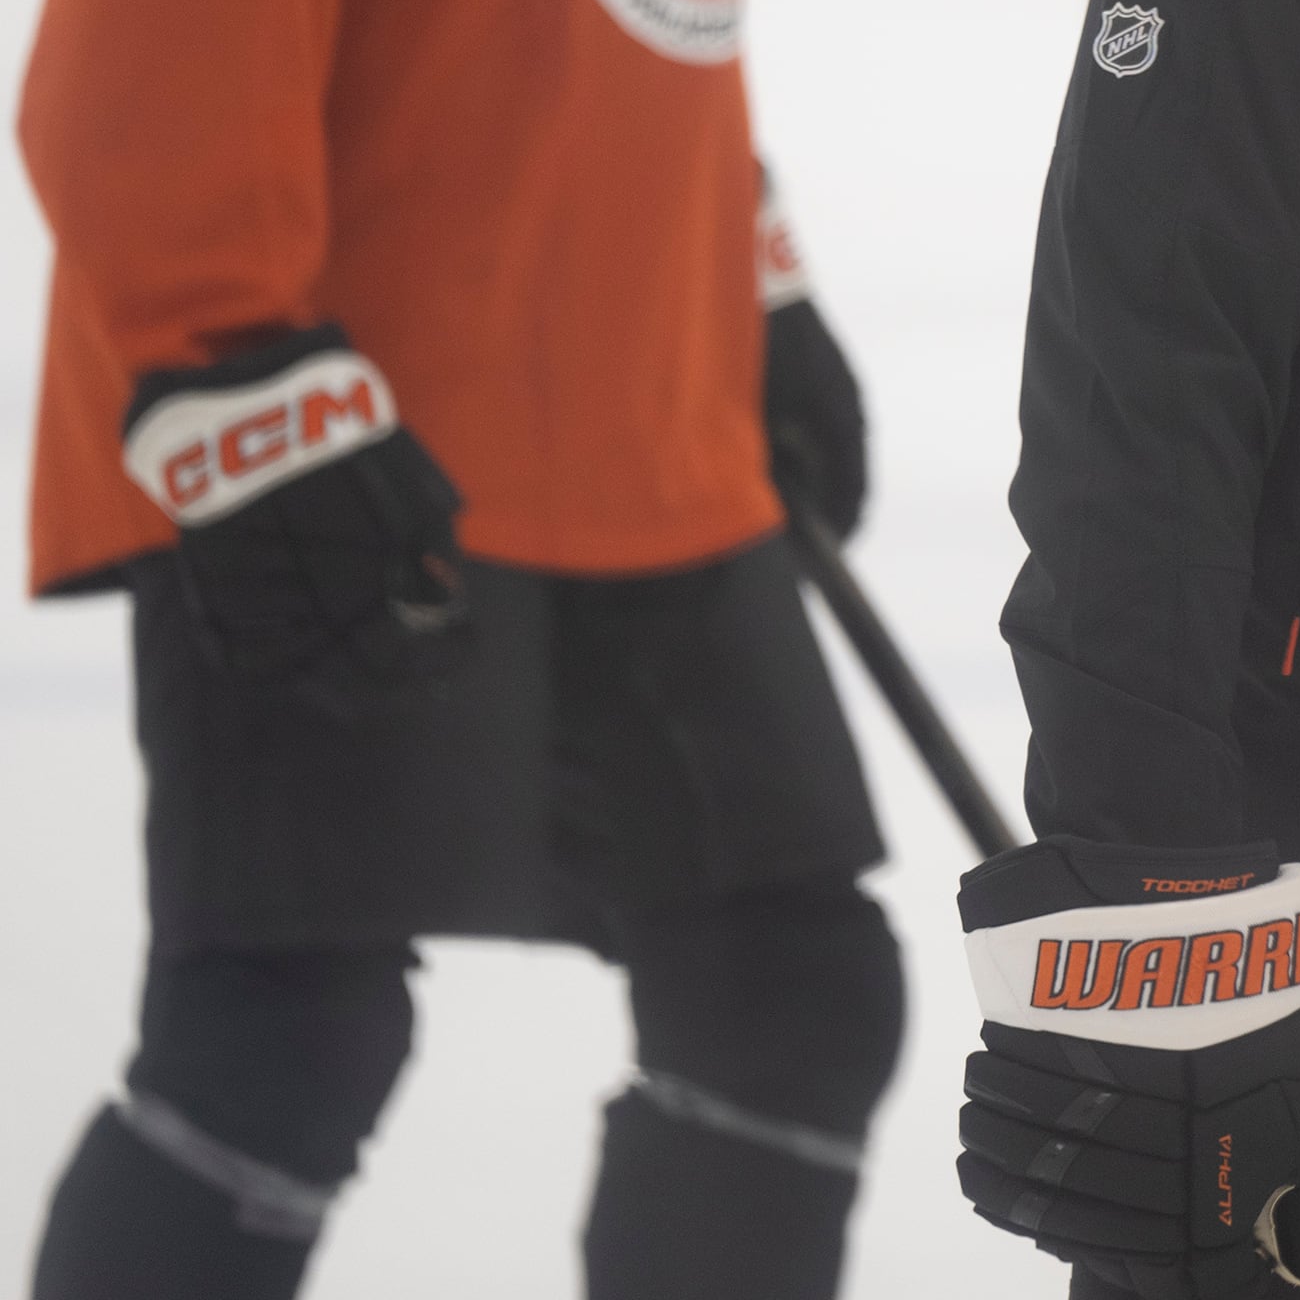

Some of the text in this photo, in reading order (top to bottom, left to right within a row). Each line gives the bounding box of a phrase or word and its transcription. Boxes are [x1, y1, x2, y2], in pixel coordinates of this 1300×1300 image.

[1106, 25, 1149, 58] NHL
[161, 374, 379, 511] CCM
[1217, 1133, 1233, 1227] ALPHA
